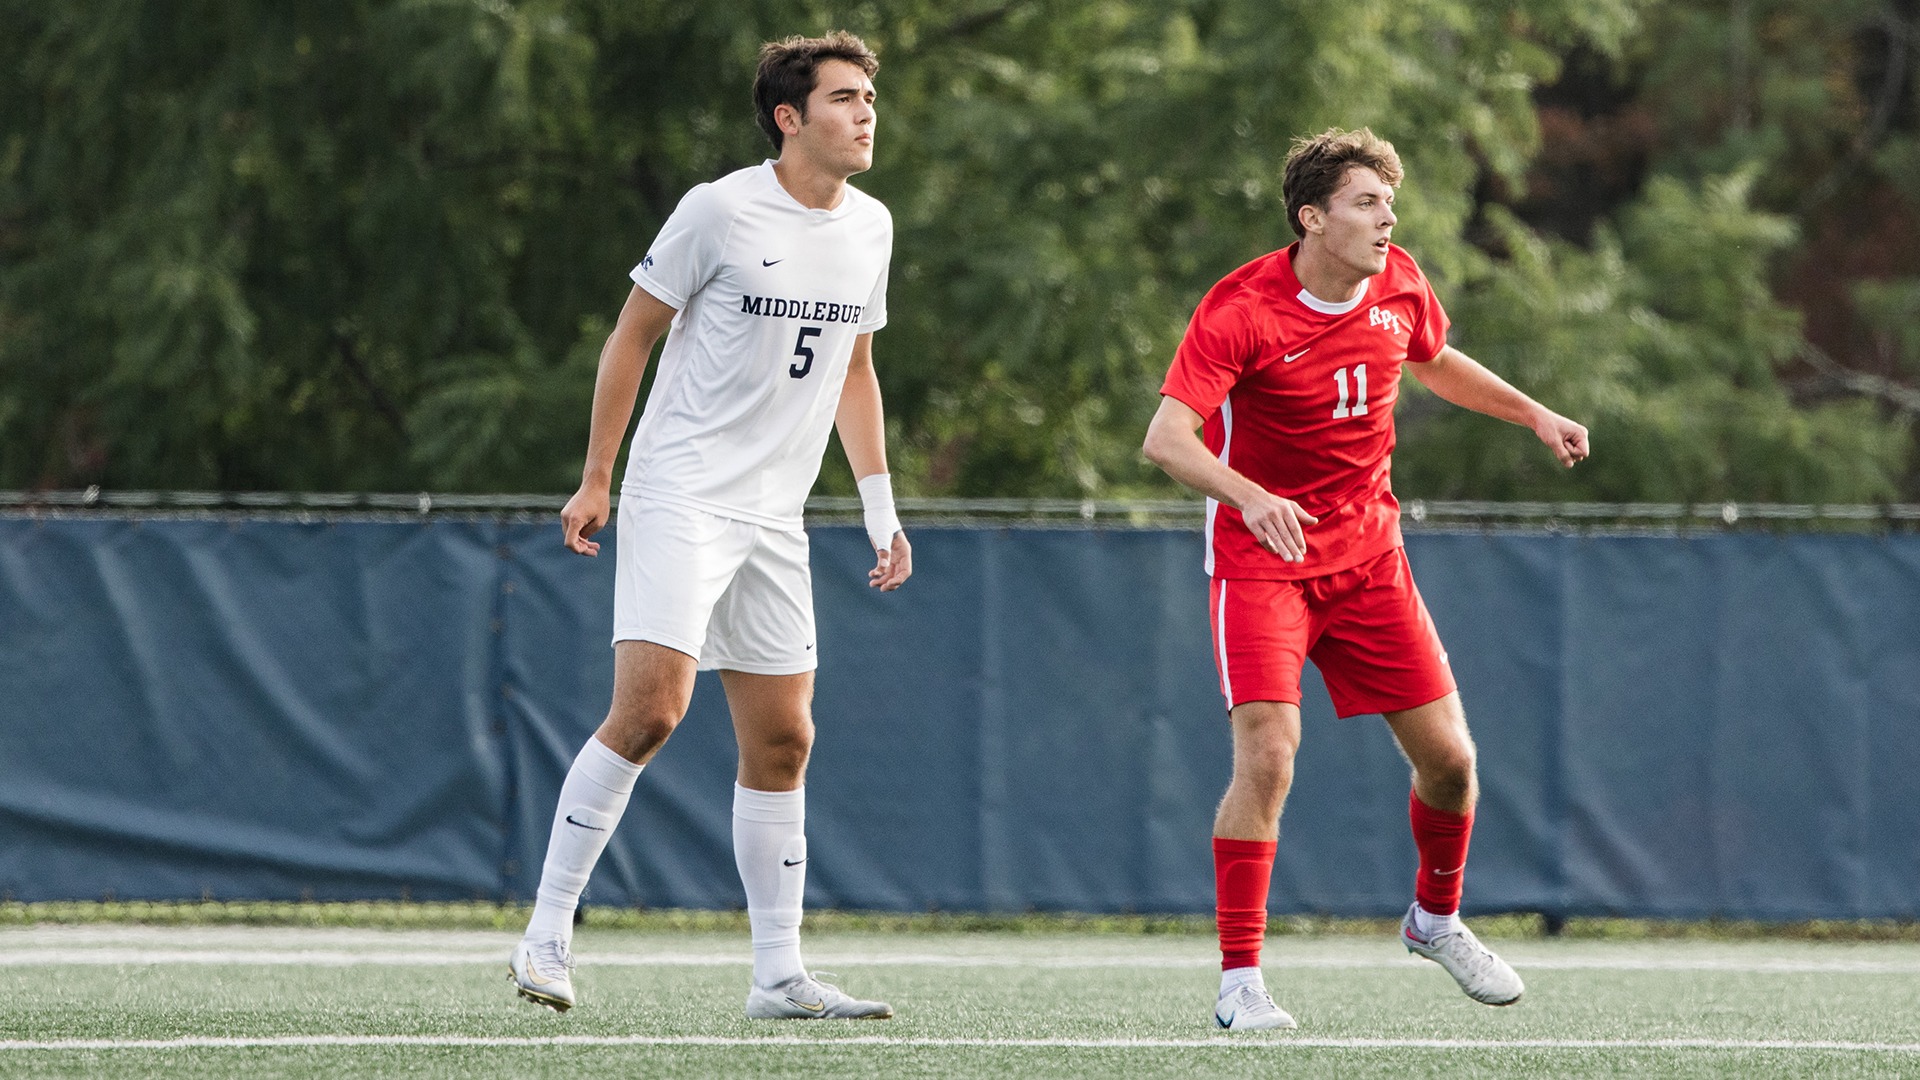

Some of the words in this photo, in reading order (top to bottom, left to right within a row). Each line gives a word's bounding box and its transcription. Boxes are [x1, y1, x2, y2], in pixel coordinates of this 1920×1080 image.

[741, 295, 865, 324] MIDDLEBUR
[1369, 306, 1400, 335] RPI
[789, 327, 822, 379] 5
[1333, 364, 1368, 419] 11
